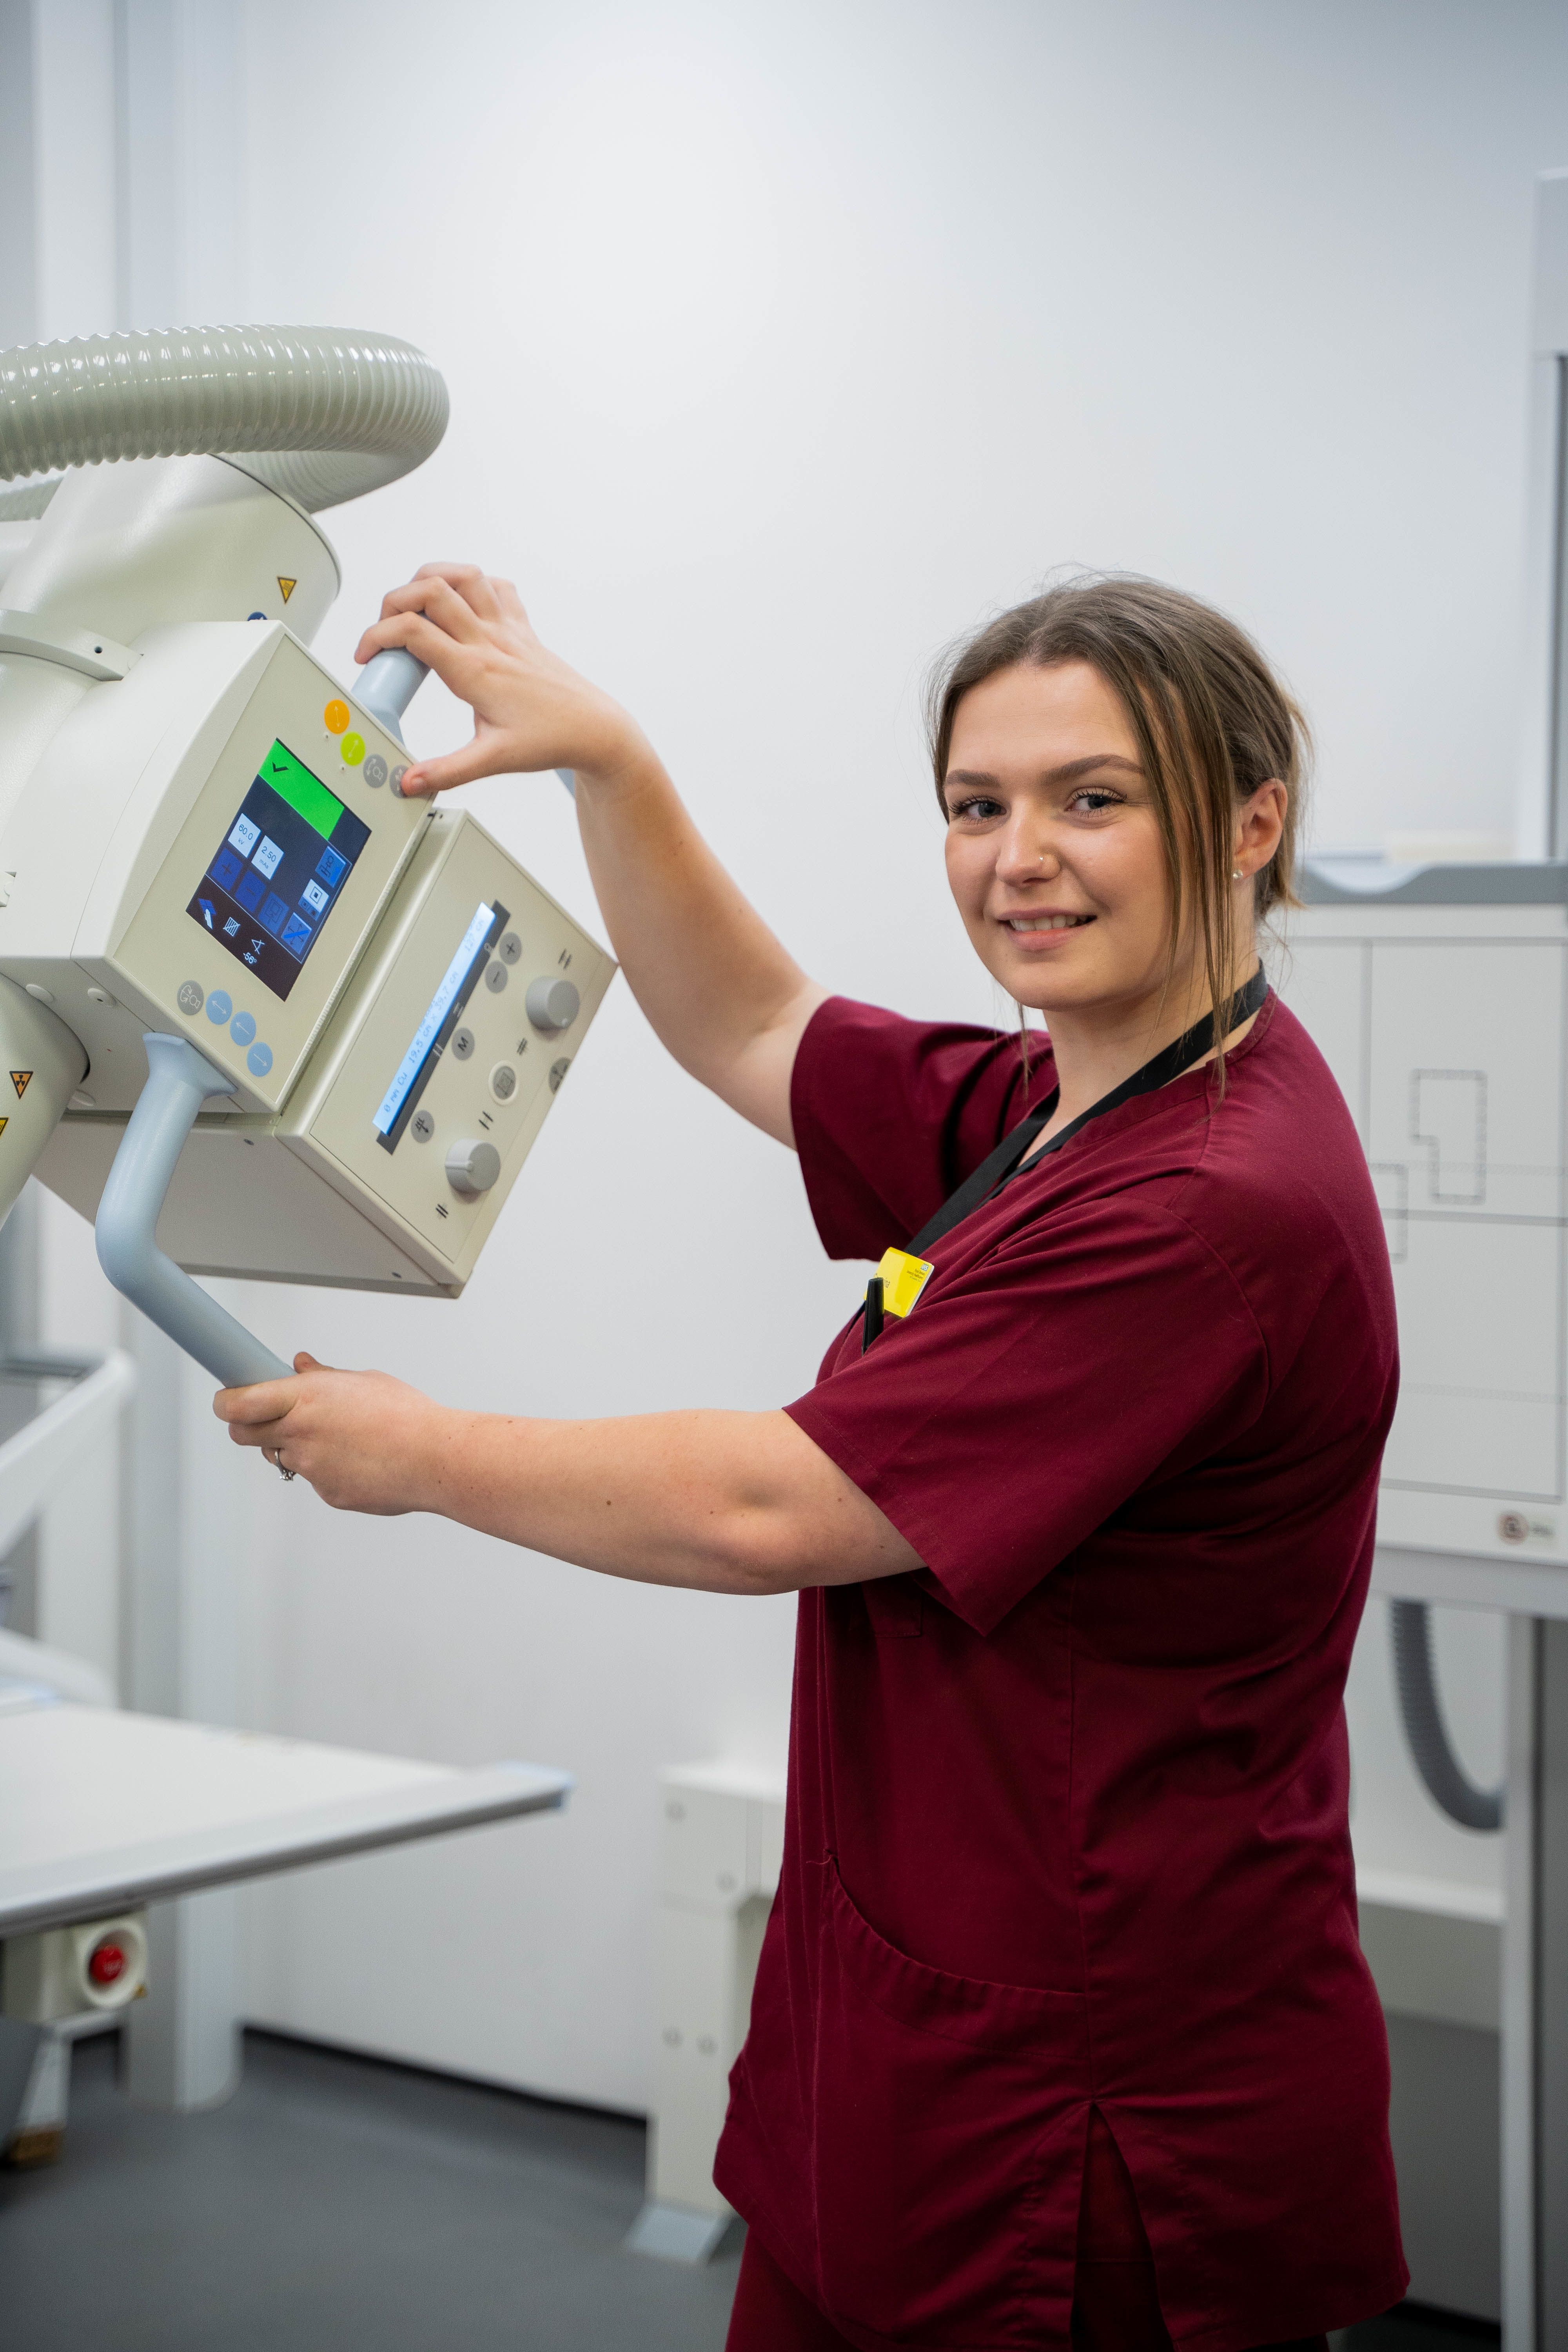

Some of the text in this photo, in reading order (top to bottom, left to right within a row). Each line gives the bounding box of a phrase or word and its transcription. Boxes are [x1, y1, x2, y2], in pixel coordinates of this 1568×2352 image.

[238, 824, 253, 840] 60.0
[261, 846, 276, 862] 2.50
[260, 859, 269, 869] mAs
[243, 952, 257, 964] -56°
[408, 1039, 423, 1063] 19.5
[457, 1036, 468, 1051] M
